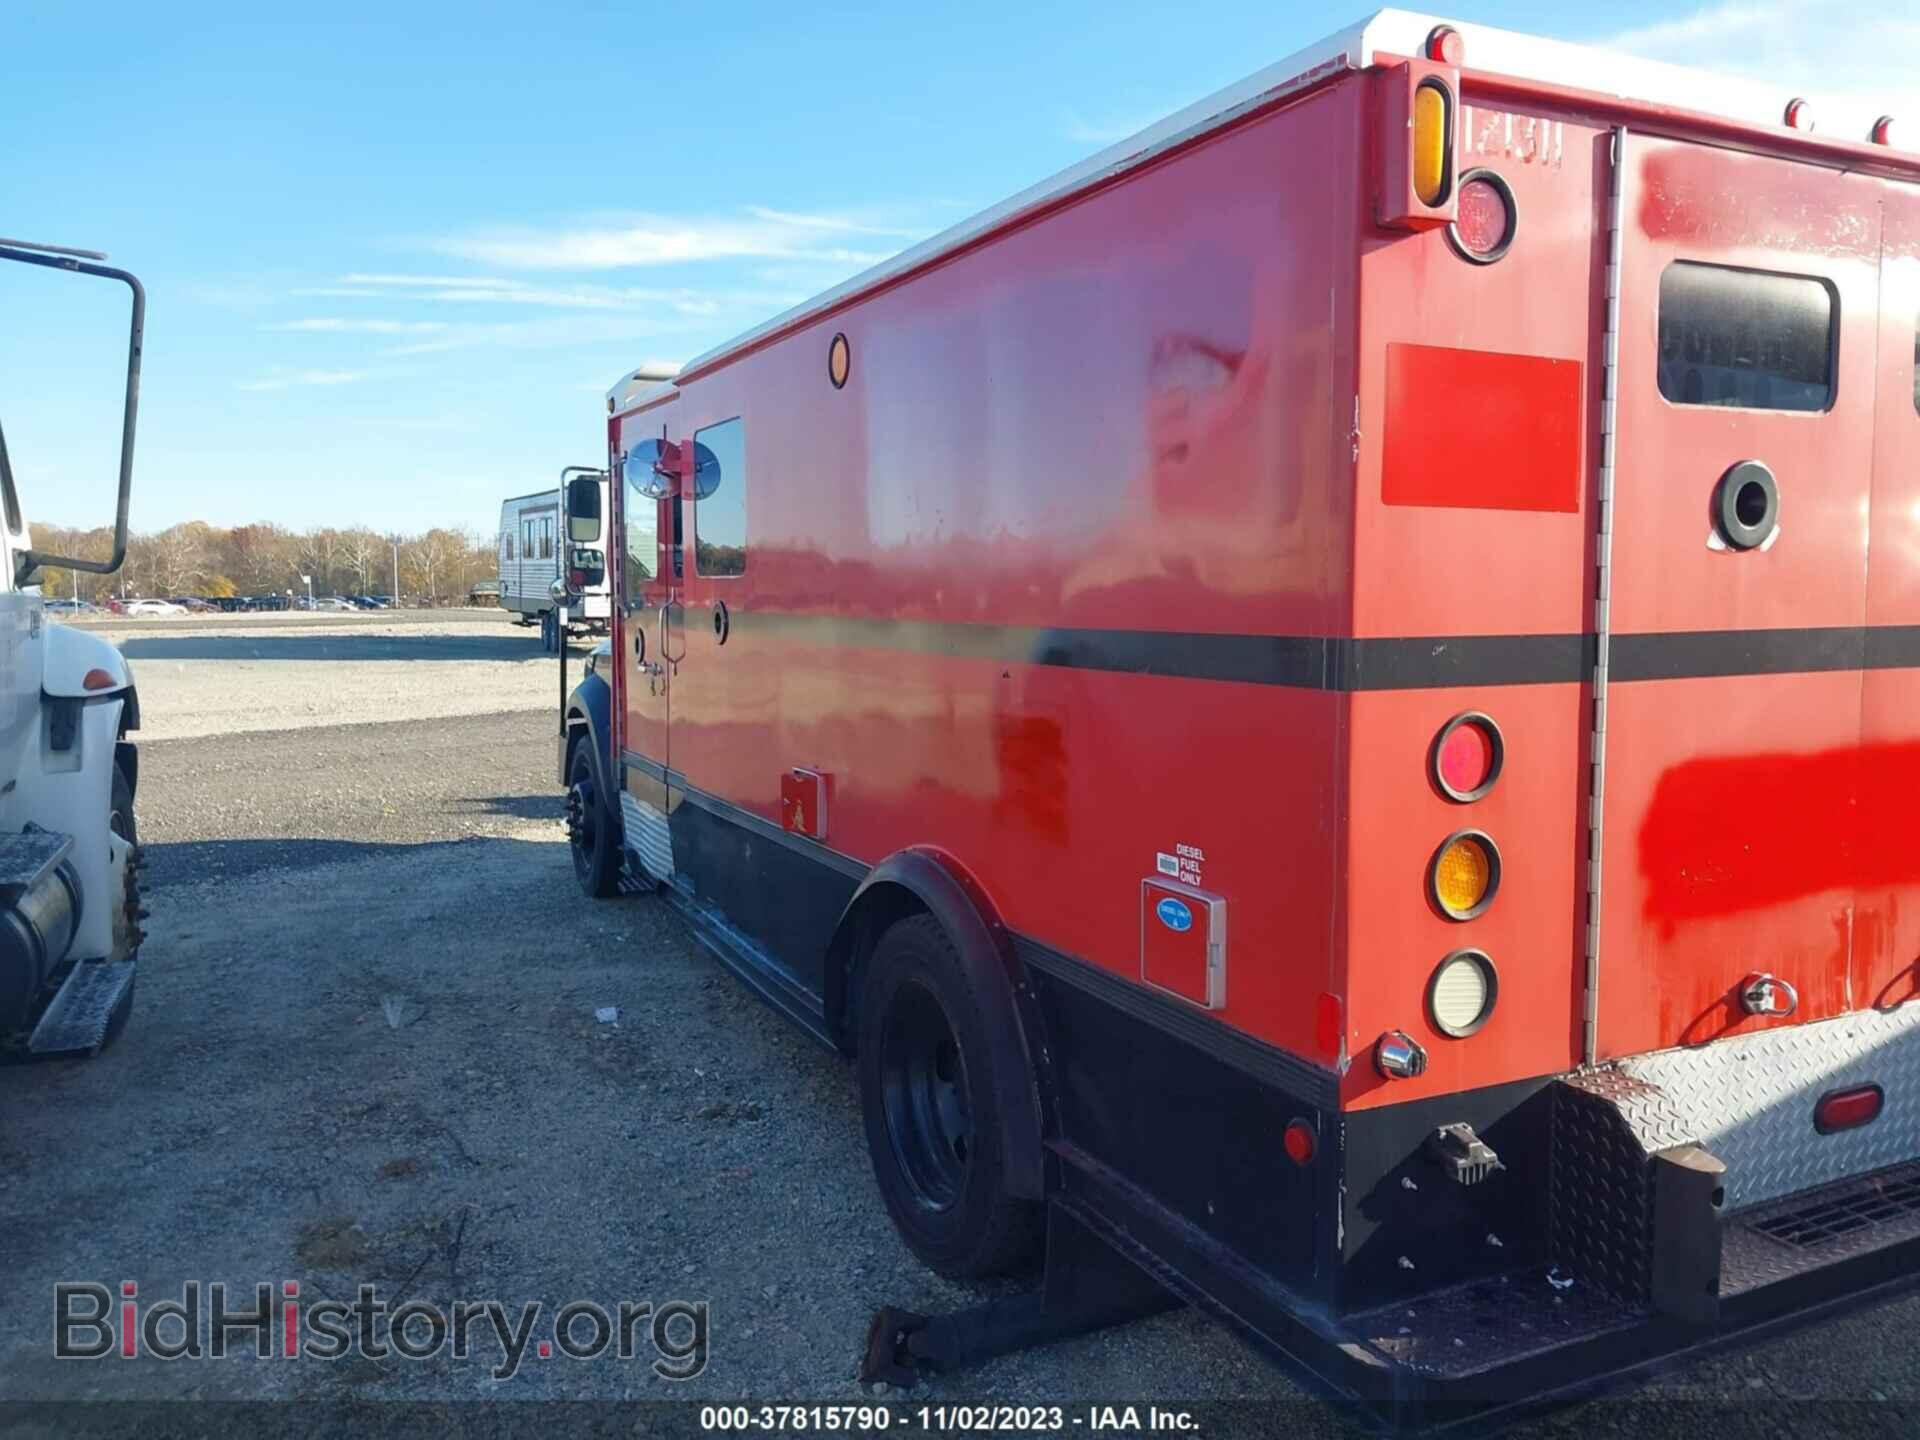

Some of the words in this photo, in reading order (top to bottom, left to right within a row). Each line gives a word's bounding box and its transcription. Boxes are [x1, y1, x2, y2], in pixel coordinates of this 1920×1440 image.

[1176, 843, 1205, 861] DIESEL
[1179, 857, 1201, 873] FUEL
[1180, 870, 1202, 886] ONLY
